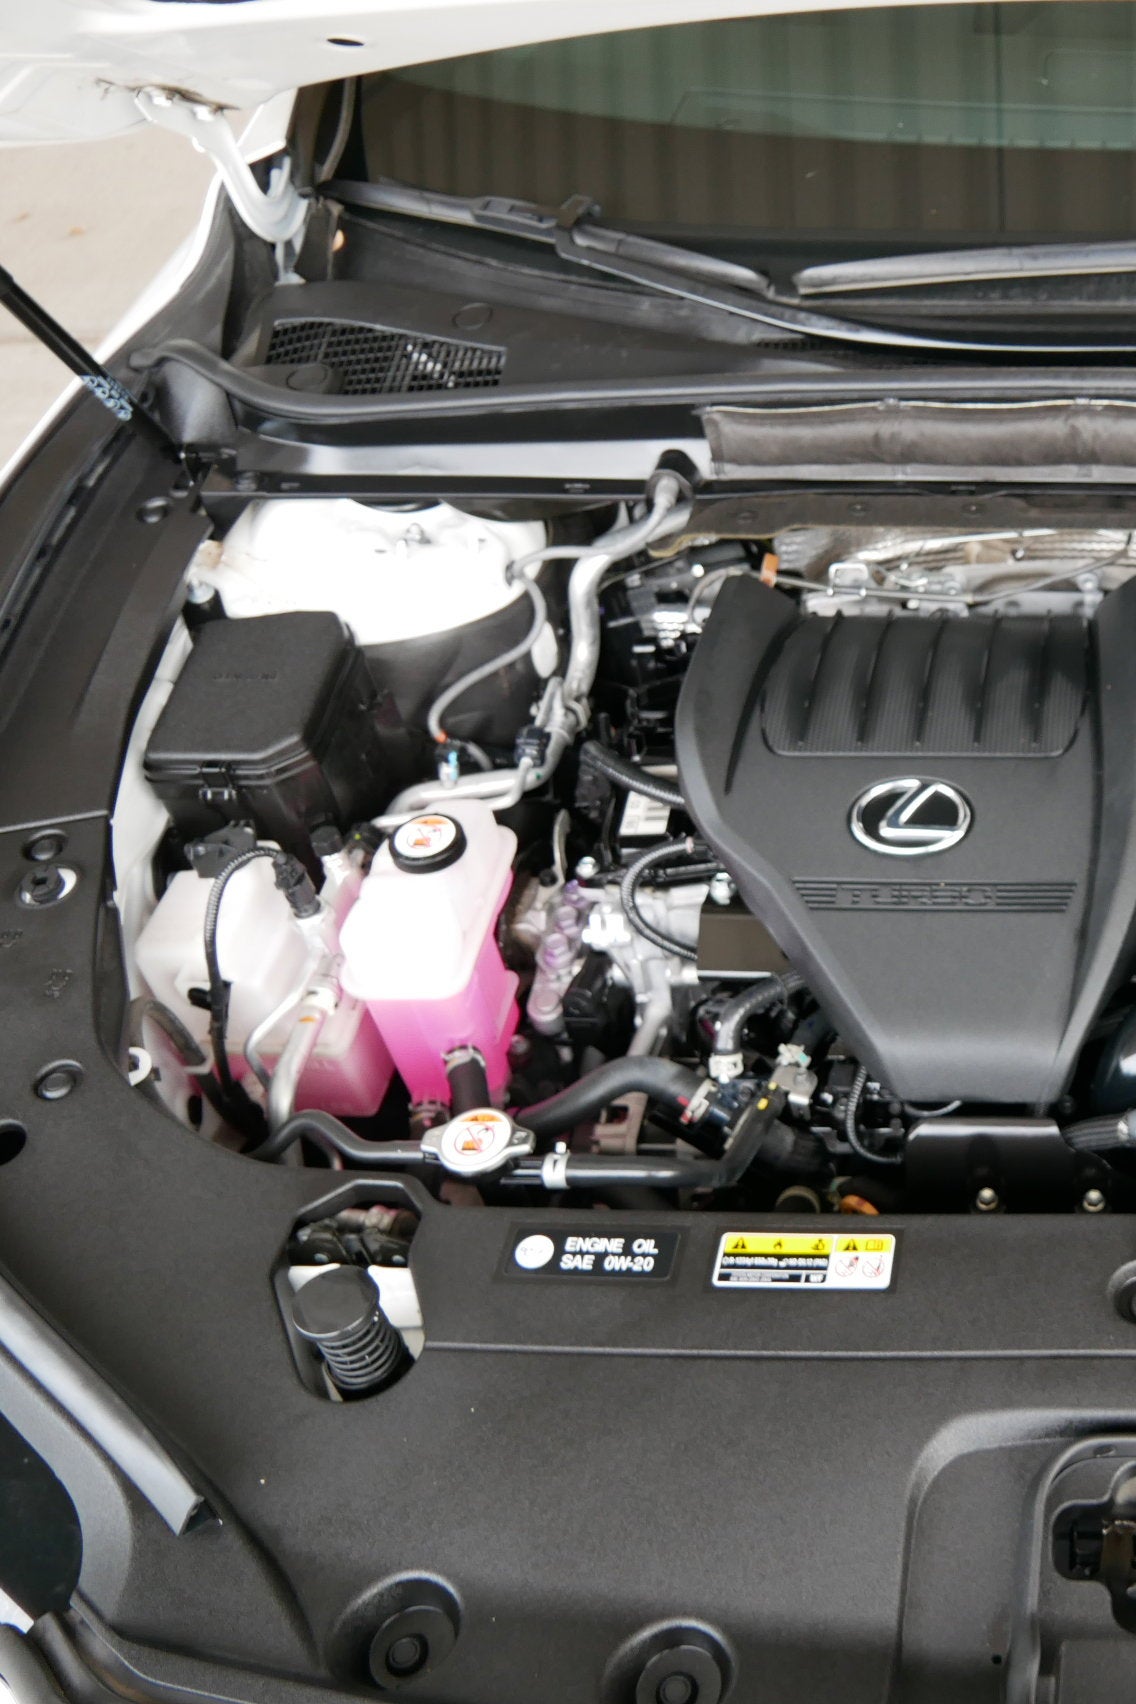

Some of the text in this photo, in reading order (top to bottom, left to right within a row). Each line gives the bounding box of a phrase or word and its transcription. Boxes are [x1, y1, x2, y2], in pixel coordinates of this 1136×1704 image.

[838, 885, 993, 906] TURBO
[564, 1236, 659, 1254] ENGINE OIL
[560, 1253, 655, 1272] SAE 0W-20
